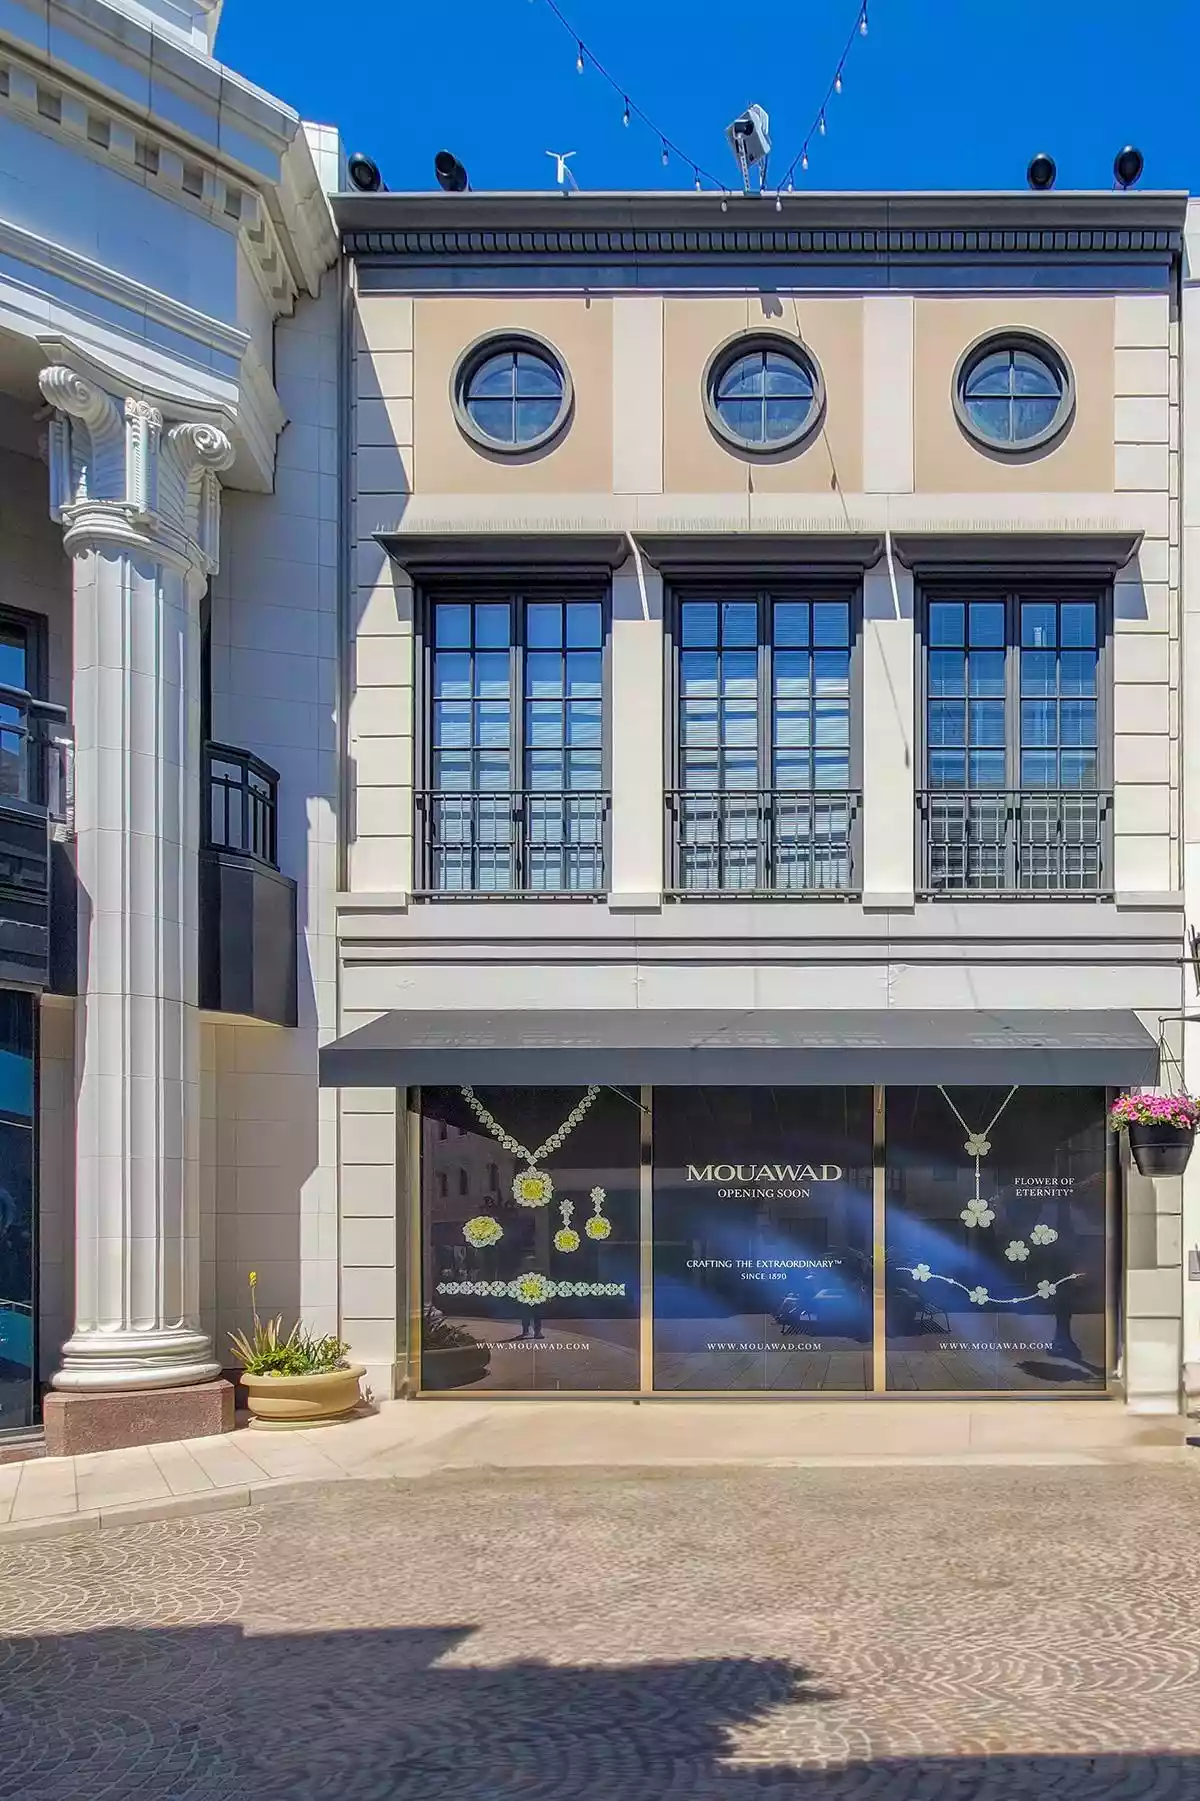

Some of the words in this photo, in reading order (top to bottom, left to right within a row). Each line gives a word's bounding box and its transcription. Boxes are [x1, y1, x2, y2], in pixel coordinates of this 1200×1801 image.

[685, 1164, 843, 1182] MOUAWAD
[1014, 1177, 1059, 1186] FLOWER
[1060, 1177, 1075, 1186] OF
[717, 1188, 775, 1199] OPENING
[776, 1188, 811, 1198] SOON
[686, 1259, 733, 1269] CRAFTING
[735, 1259, 753, 1268] THE
[740, 1272, 766, 1280] SINCE
[768, 1272, 787, 1280] 1890
[475, 1342, 590, 1351] WWW.MOUAWAD.COM
[706, 1342, 822, 1351] WWW.MOUAWAD.COM
[939, 1342, 1054, 1350] WWW.MOUAWAD.COM
